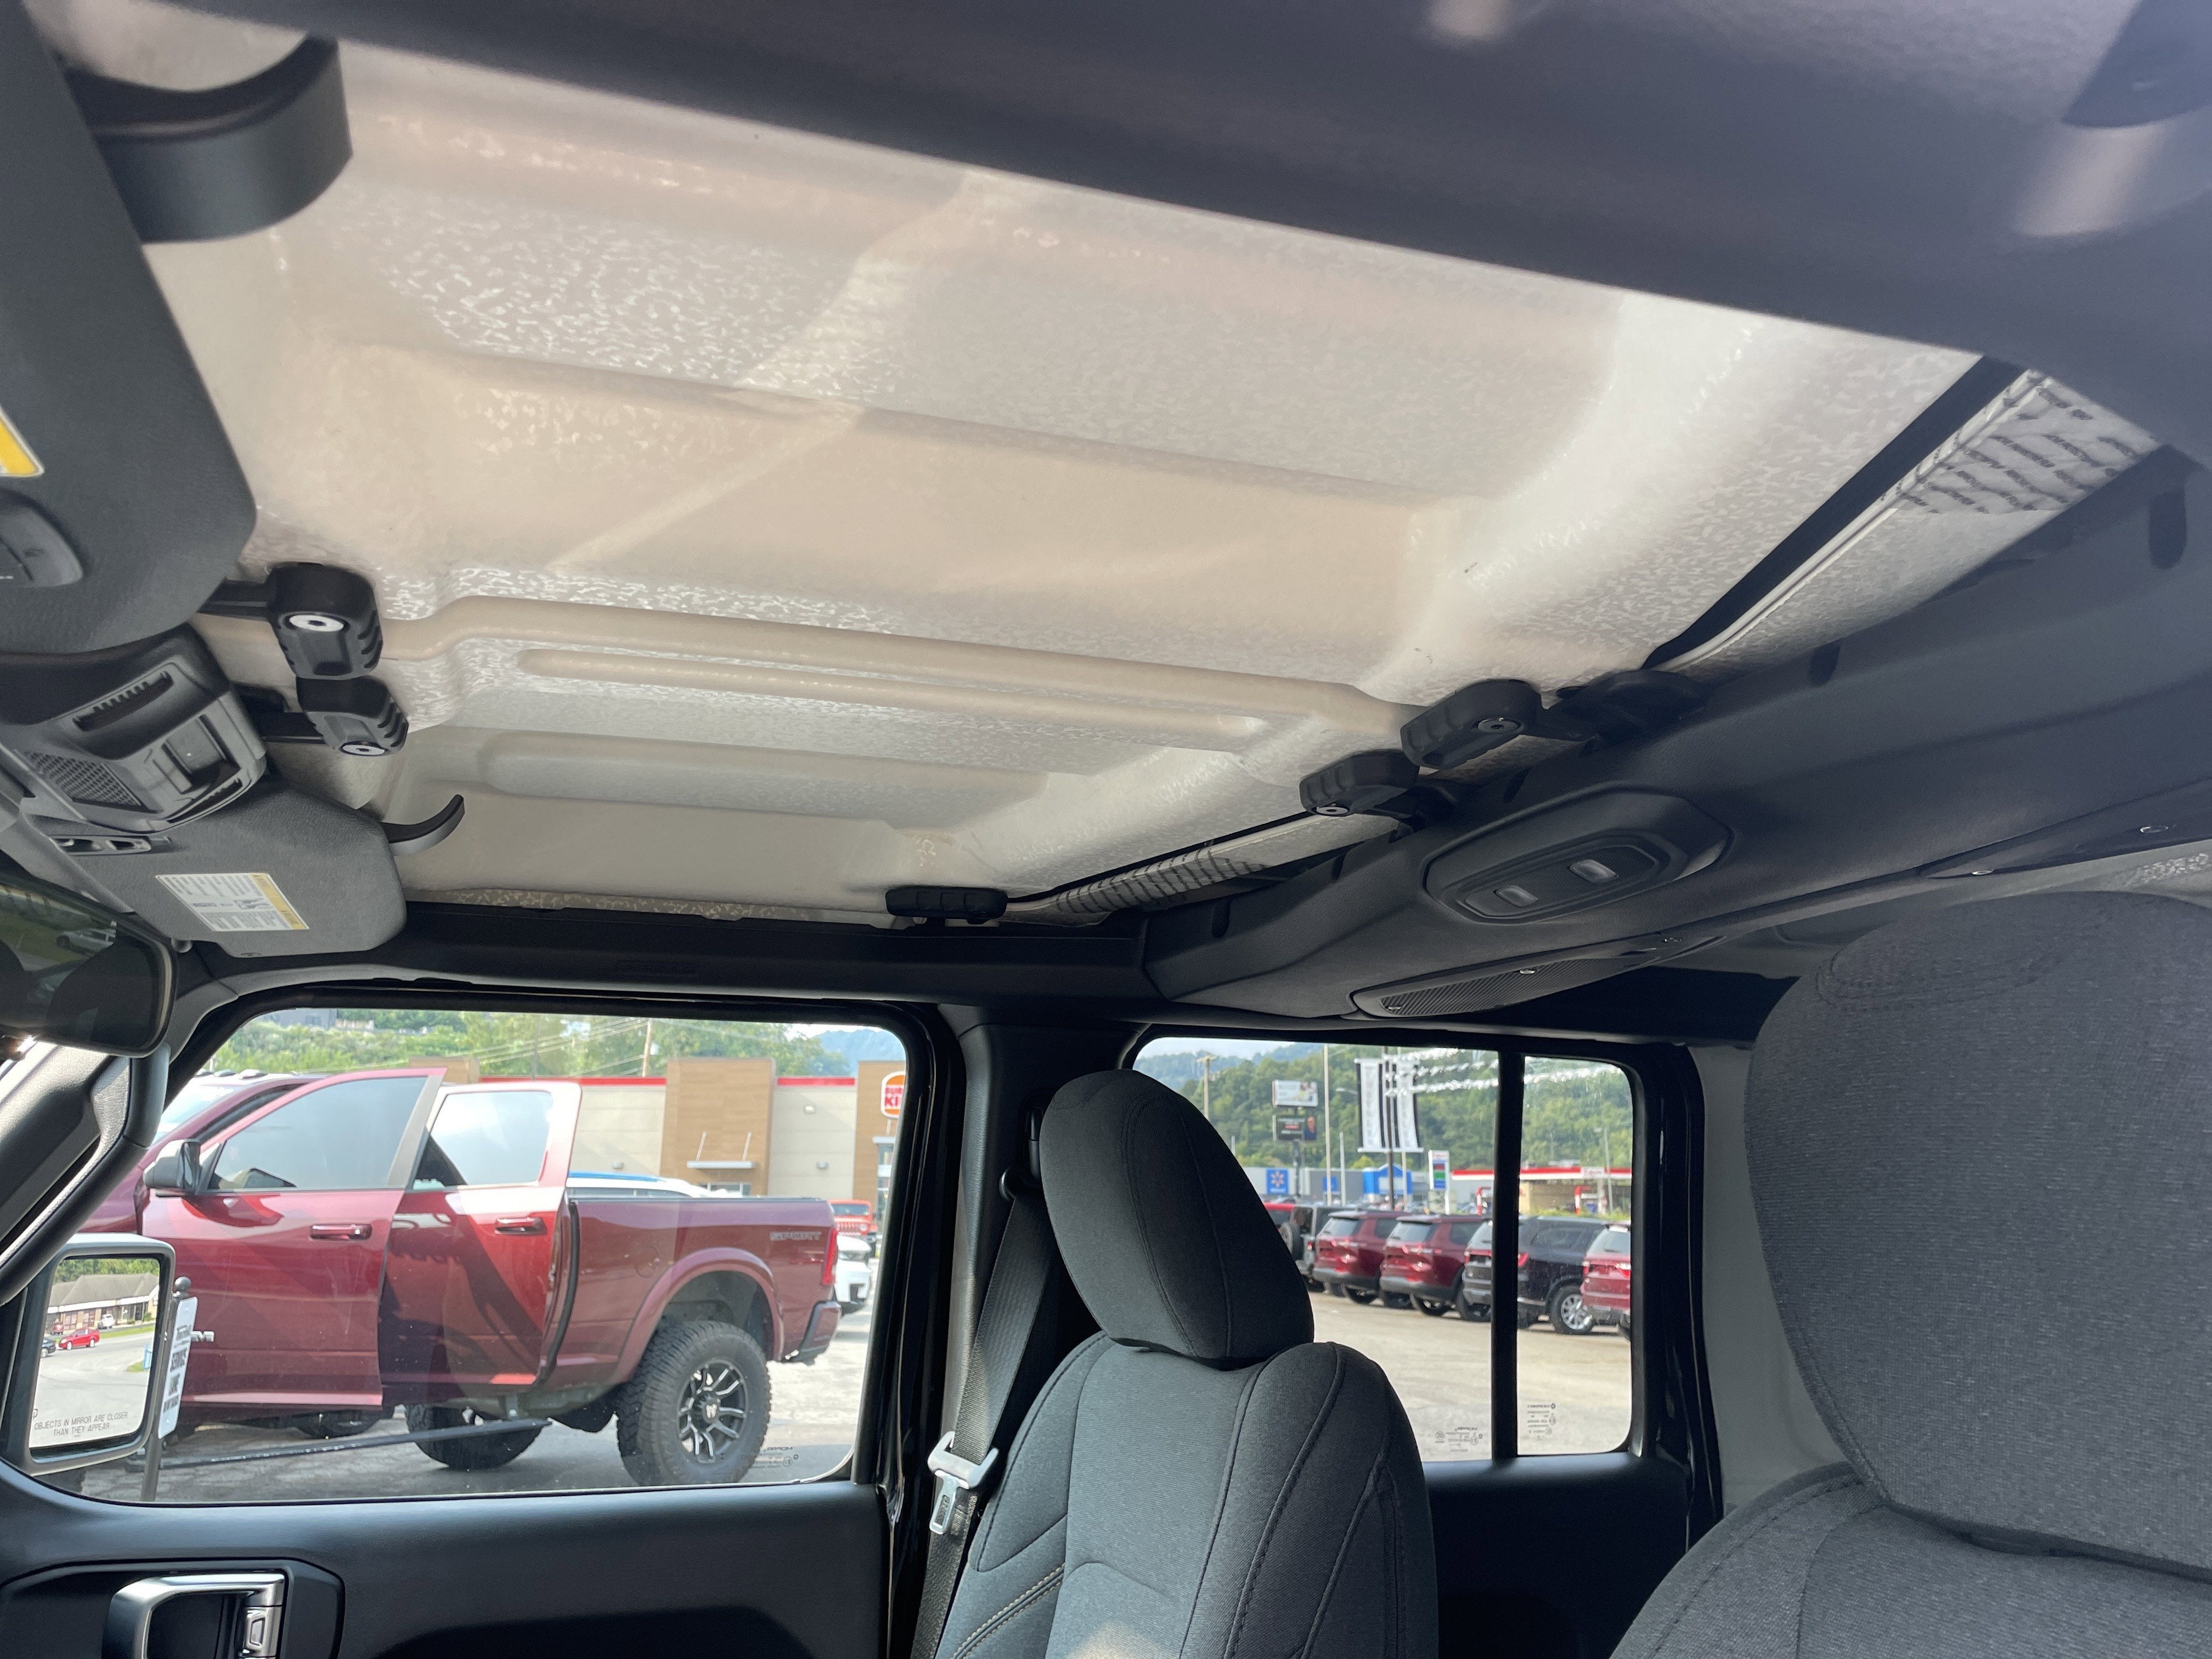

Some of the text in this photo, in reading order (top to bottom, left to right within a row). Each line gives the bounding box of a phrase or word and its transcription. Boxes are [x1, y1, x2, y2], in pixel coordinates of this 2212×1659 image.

[770, 1232, 821, 1241] SPORT
[34, 1420, 61, 1430] OBJECTS
[71, 1415, 92, 1425] MIRROR
[94, 1414, 105, 1422] ARE
[107, 1412, 128, 1421] CLOSER
[53, 1423, 110, 1436] THAN THEY APPEAR
